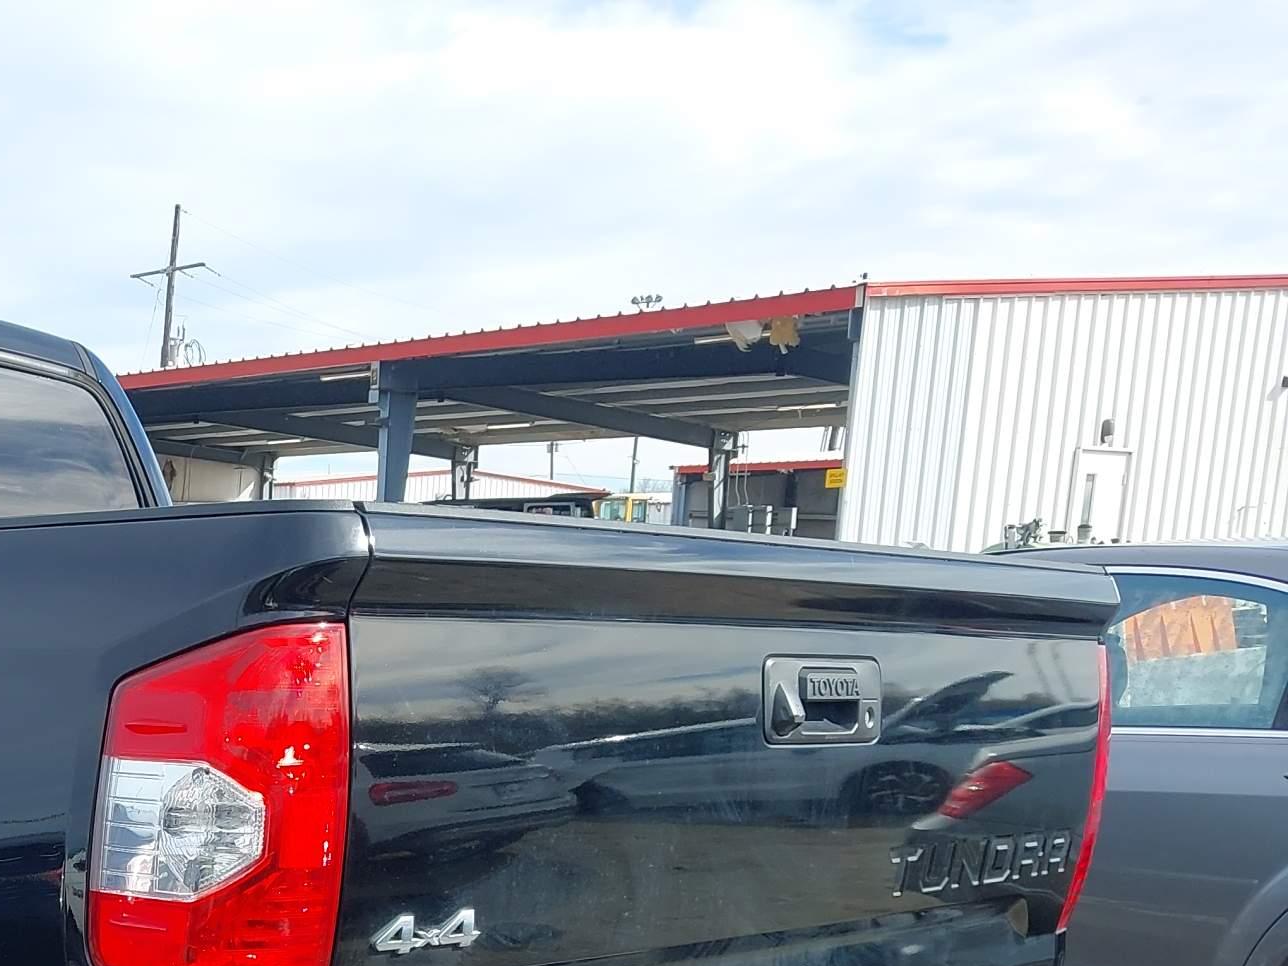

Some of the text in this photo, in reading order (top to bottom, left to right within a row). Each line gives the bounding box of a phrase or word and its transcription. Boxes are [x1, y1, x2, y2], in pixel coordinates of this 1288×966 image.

[809, 677, 860, 697] TOYOTA
[889, 828, 1073, 897] TUNDRA
[369, 906, 482, 955] 4x4
